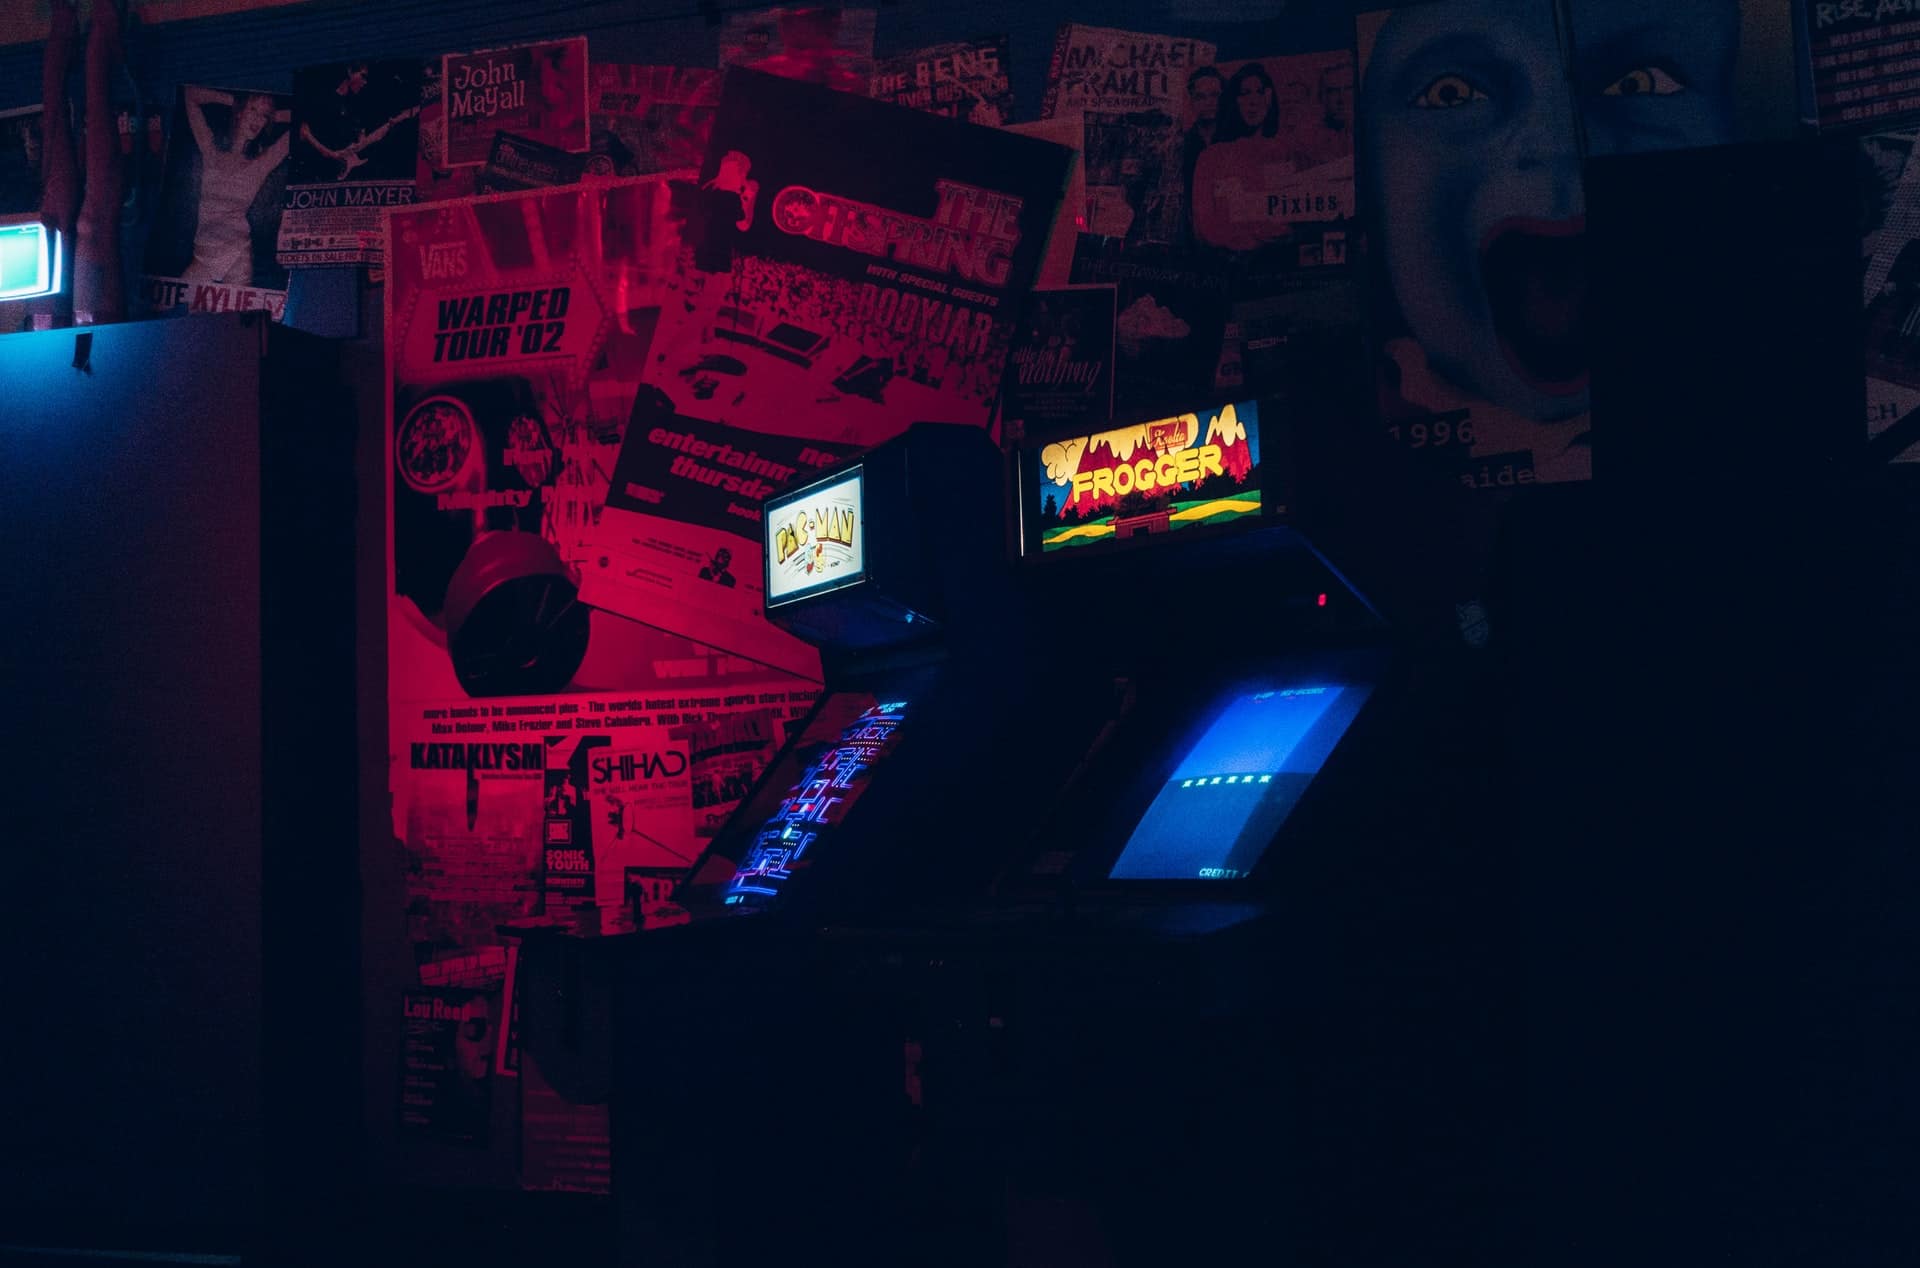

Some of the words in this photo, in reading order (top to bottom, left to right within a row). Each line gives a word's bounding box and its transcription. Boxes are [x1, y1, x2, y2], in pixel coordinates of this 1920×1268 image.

[454, 59, 516, 91] John
[450, 80, 526, 118] Mayall
[286, 189, 338, 209] JOHN
[344, 186, 413, 206] MAYER
[936, 178, 1023, 241] THE
[1267, 193, 1337, 217] Pixies
[419, 240, 469, 280] VANS
[191, 283, 257, 312] KYLIE
[899, 272, 948, 294] SPECIAL
[438, 288, 570, 331] WARPED
[857, 282, 993, 357] BODYJAR
[433, 326, 511, 363] TOUR
[517, 321, 565, 354] '02
[1387, 417, 1475, 449] 1996
[1072, 444, 1223, 504] FROGGER
[776, 507, 855, 566] PAC-MAN
[450, 706, 478, 718] bands
[480, 706, 489, 717] to
[491, 705, 503, 717] be
[506, 703, 556, 716] announced
[559, 702, 578, 716] plus
[588, 701, 605, 712] The
[608, 700, 642, 712] worlds
[678, 697, 721, 709] extreme
[723, 695, 756, 710] sports
[758, 693, 786, 706] stars
[431, 722, 452, 734] Max
[492, 719, 516, 732] Mike
[519, 718, 552, 731] Frazier
[556, 717, 572, 729] and
[576, 717, 602, 729] Steve
[410, 742, 547, 769] KATAKLYSM
[592, 750, 687, 785] SHIHAD
[546, 849, 585, 861] SONIC
[546, 860, 590, 872] YOUTH
[1199, 867, 1239, 879] CREDIT
[403, 994, 431, 1019] Lou
